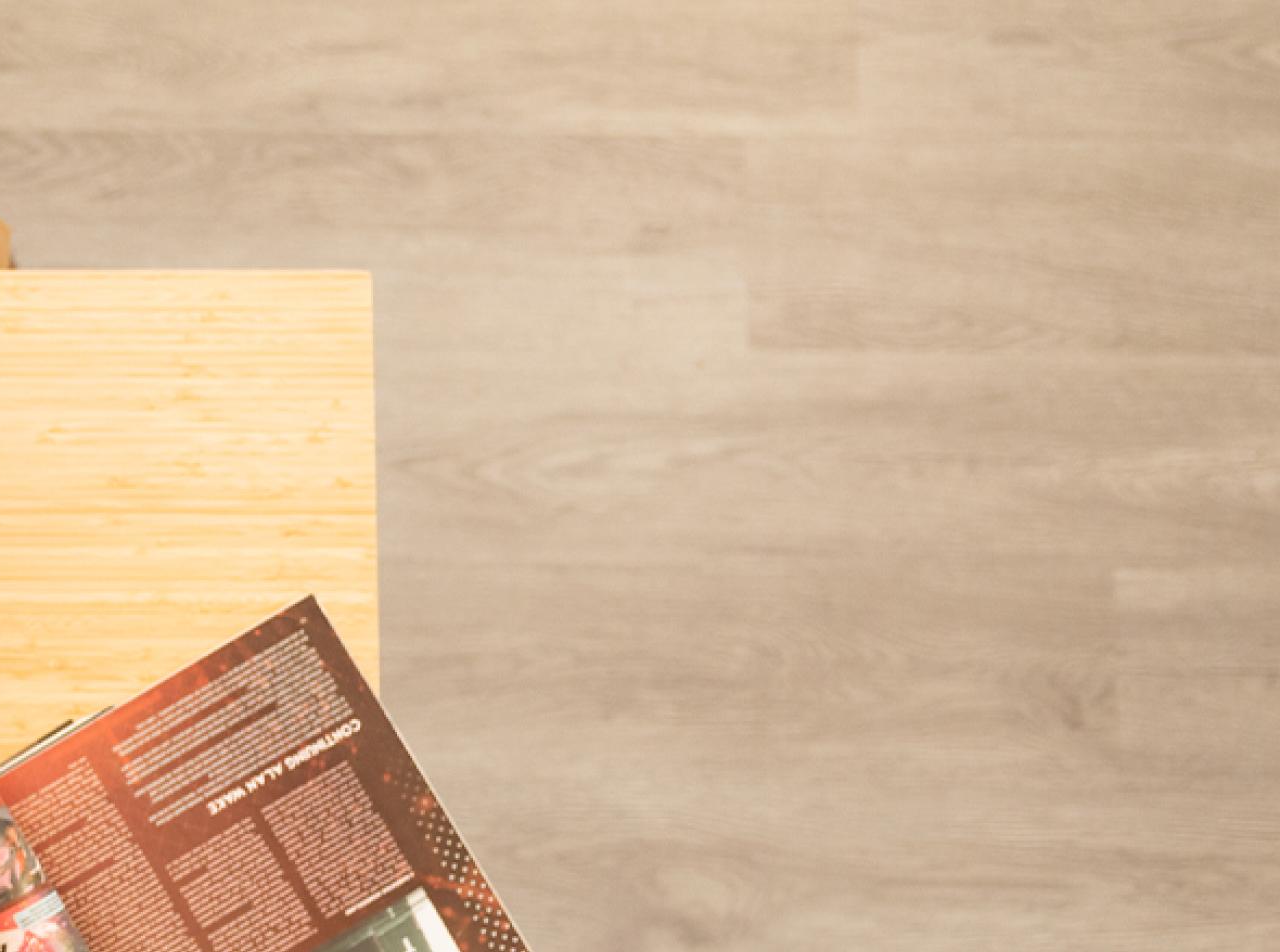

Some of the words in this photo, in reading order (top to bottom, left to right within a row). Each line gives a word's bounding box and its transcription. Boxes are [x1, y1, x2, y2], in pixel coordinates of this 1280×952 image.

[283, 718, 361, 770] CONTINUING
[245, 762, 283, 793] ALAN
[206, 786, 245, 816] WAKE
